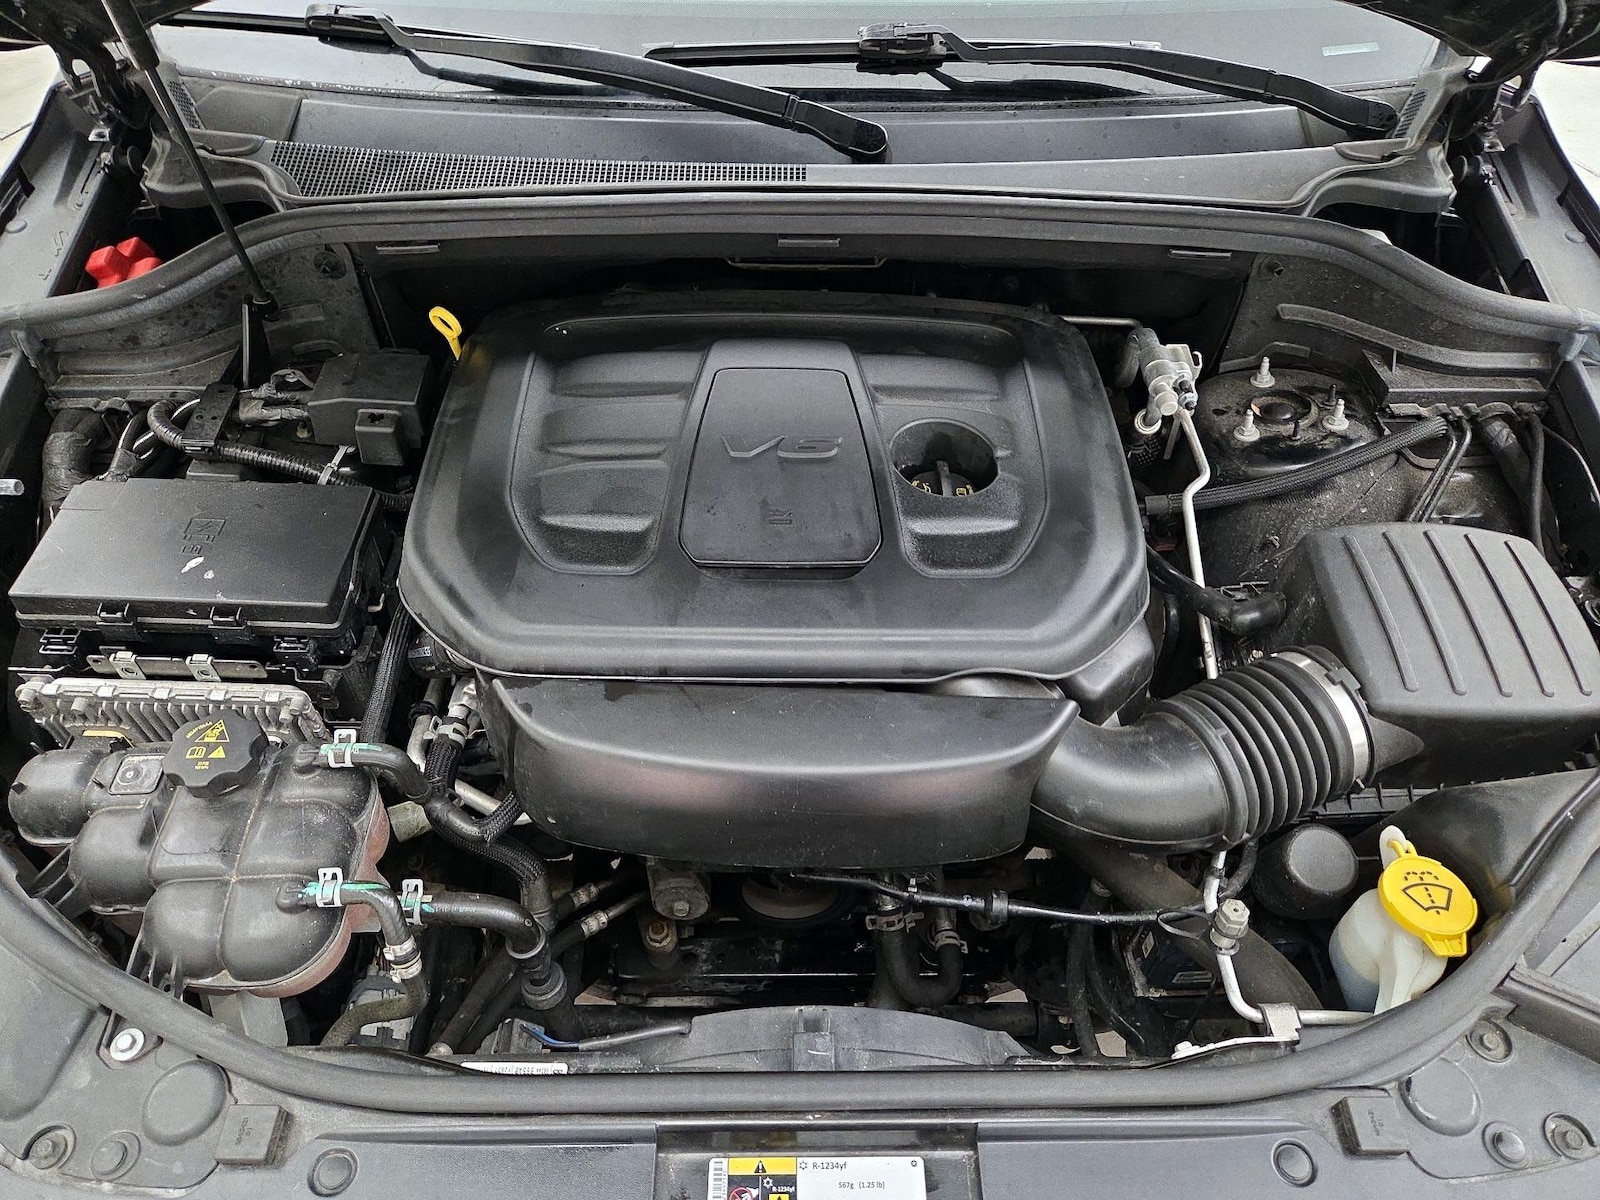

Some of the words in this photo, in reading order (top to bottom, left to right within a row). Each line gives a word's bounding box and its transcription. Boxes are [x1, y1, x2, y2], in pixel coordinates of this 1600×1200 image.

[720, 434, 843, 459] V6
[812, 1161, 847, 1171] R-1234yf
[838, 1181, 854, 1190] 567g
[858, 1181, 875, 1190] (1.25
[876, 1181, 885, 1190] lb)
